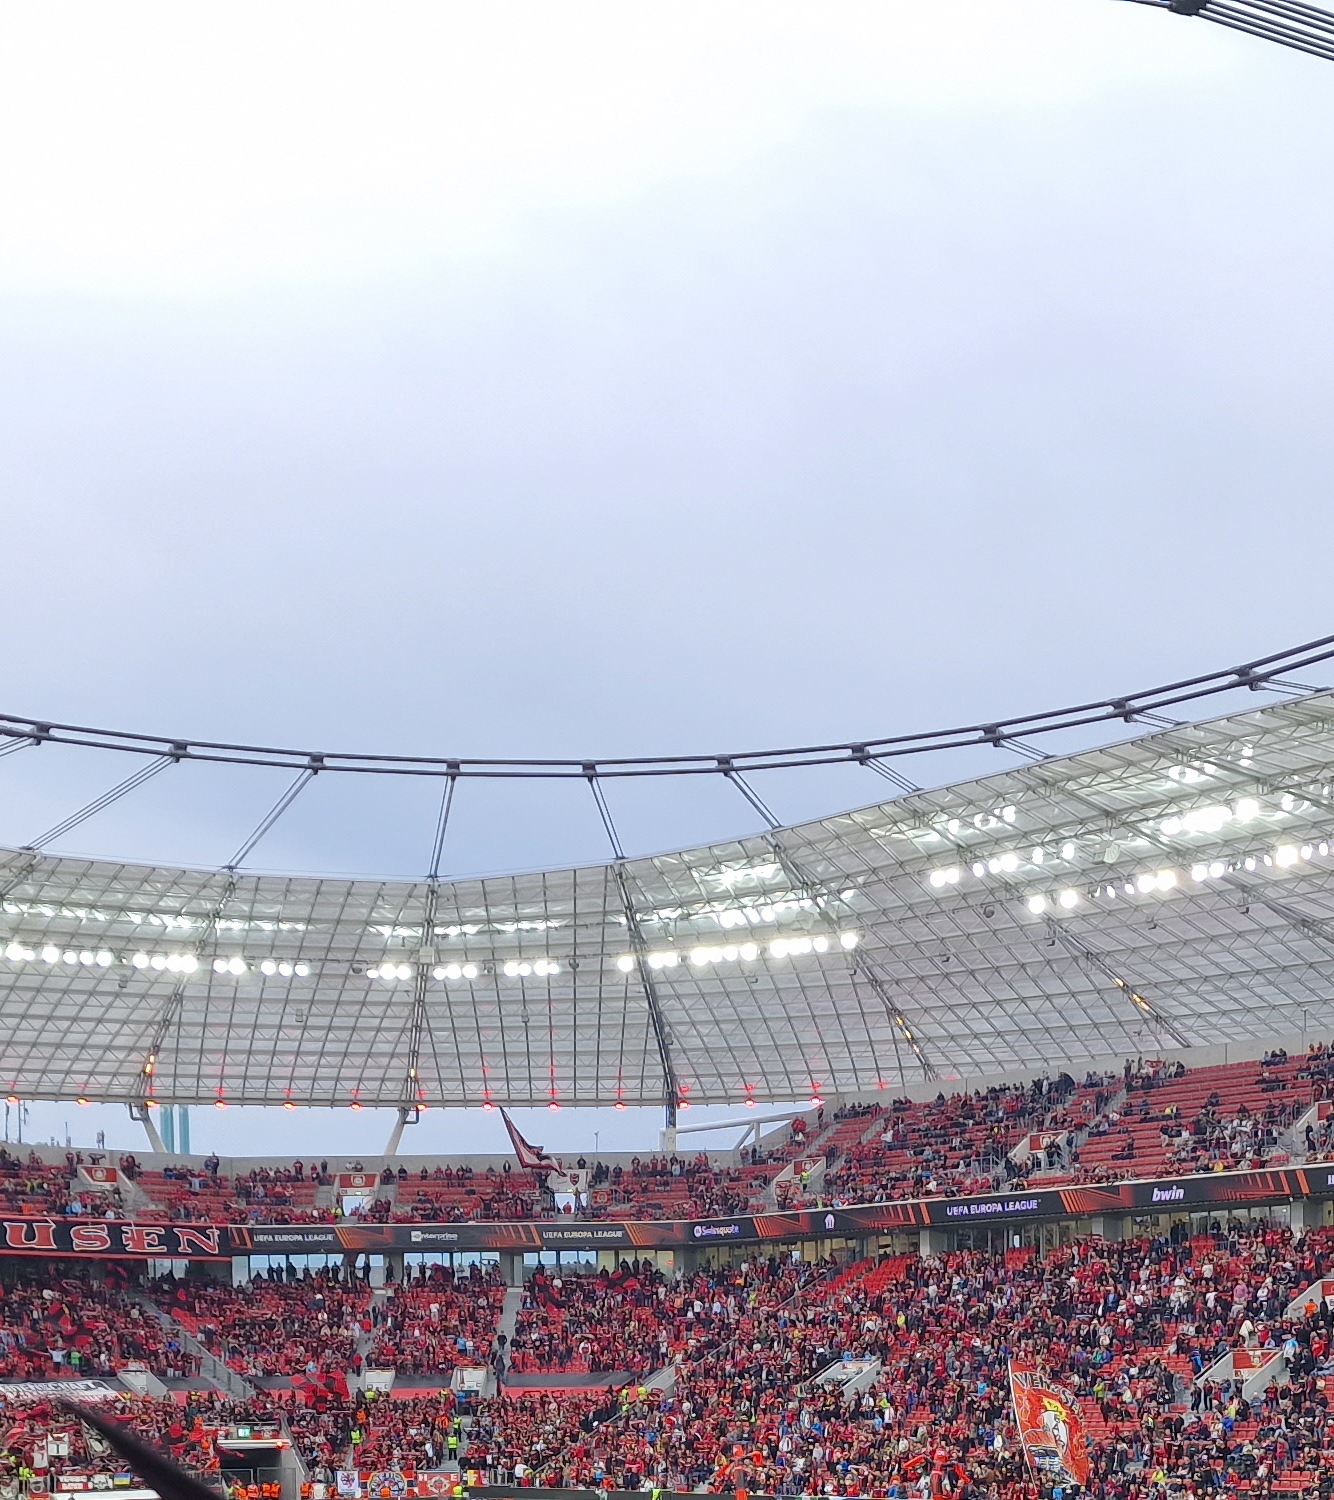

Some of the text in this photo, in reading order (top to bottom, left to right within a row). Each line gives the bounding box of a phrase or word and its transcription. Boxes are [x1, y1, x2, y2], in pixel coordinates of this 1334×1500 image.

[1151, 1185, 1185, 1202] bwin
[946, 1200, 1039, 1216] UEFA EUROPA LEAGUE
[253, 1234, 272, 1242] UEFA
[273, 1234, 300, 1242] EUROPA
[543, 1230, 624, 1239] UEFA EUROPA LEAGUE
